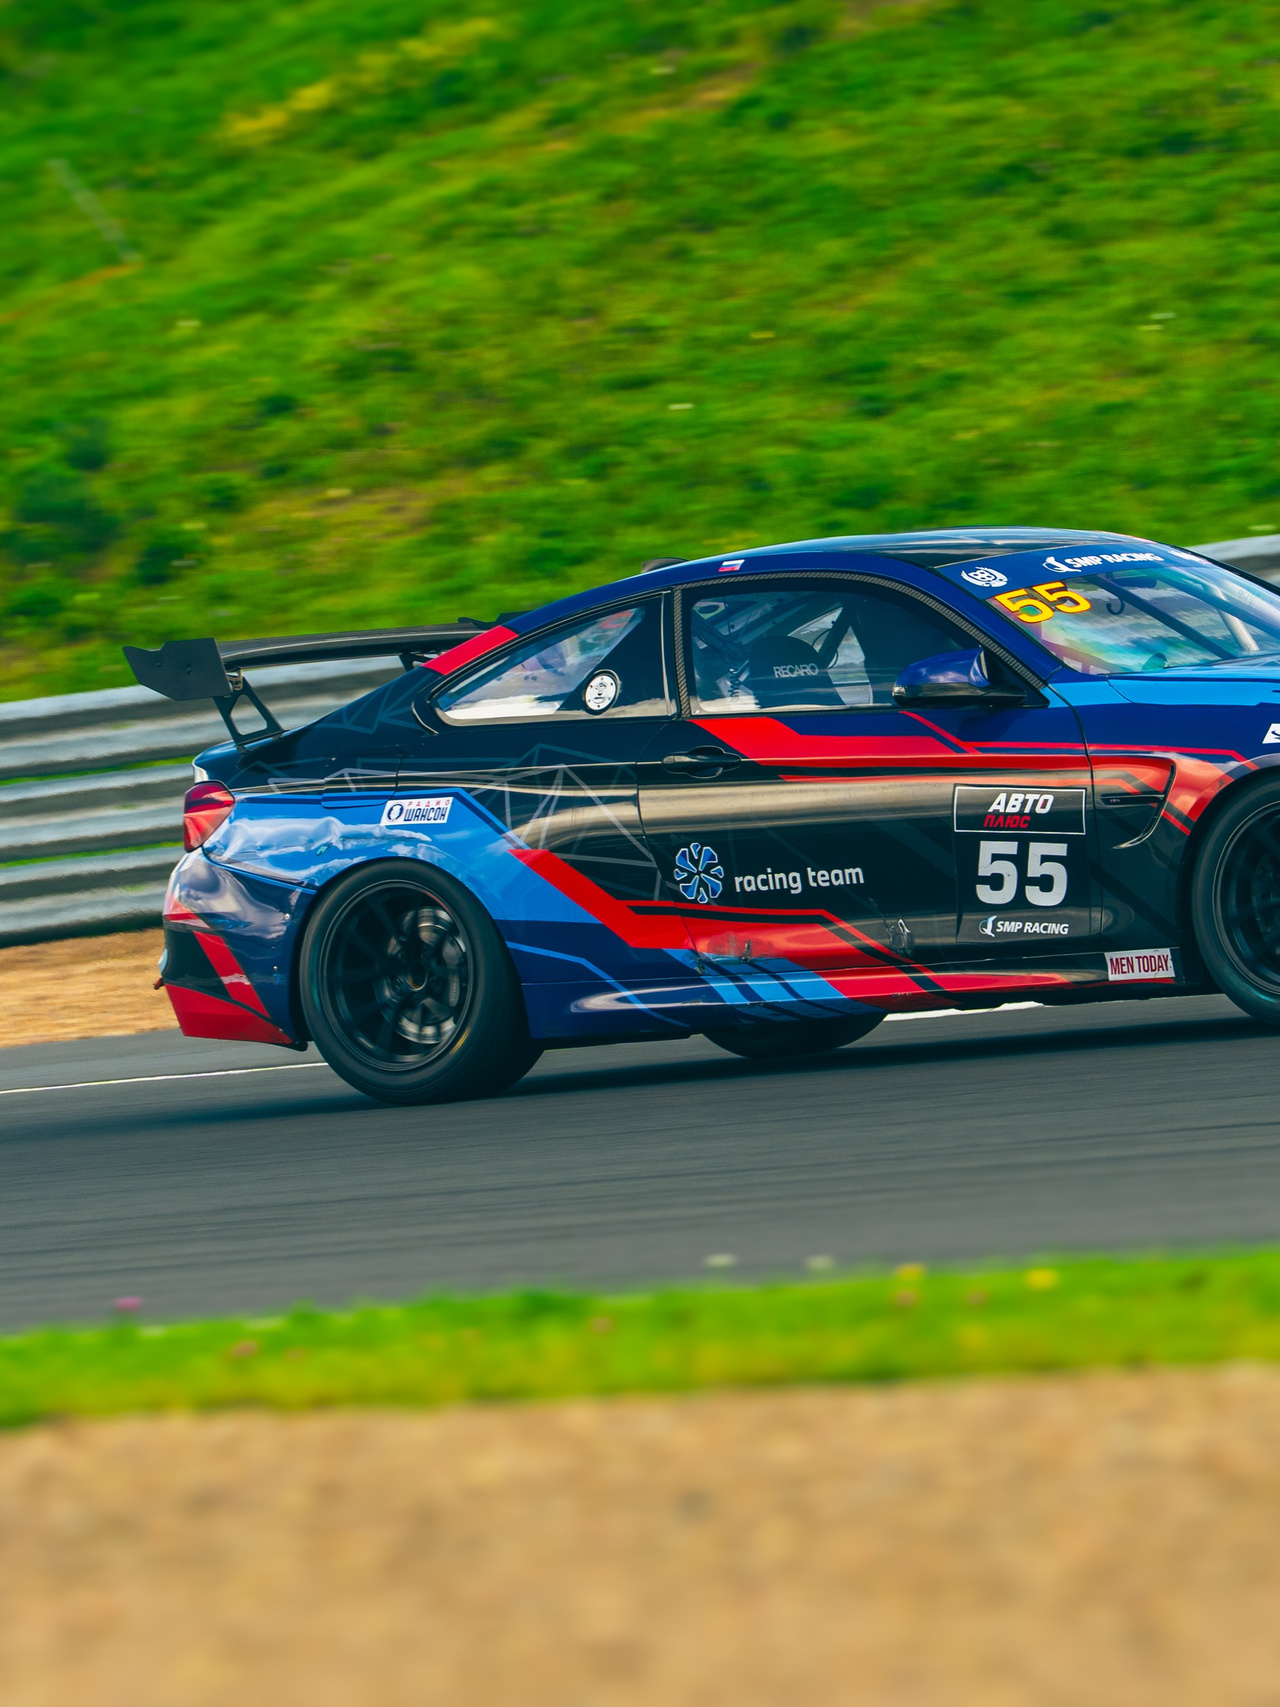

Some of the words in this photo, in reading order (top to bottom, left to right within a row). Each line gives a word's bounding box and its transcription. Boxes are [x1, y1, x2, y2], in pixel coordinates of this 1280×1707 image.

[1064, 554, 1103, 569] SMP
[1103, 553, 1165, 564] RACING
[994, 581, 1092, 623] 55
[773, 663, 819, 678] RECARO
[407, 799, 450, 807] РАДИО
[988, 793, 1054, 814] АВТО
[403, 806, 448, 822] ШАНСОН
[983, 815, 1031, 828] ПЛЮС
[734, 867, 802, 894] racing
[806, 867, 864, 887] team
[975, 840, 1068, 906] 55
[996, 920, 1023, 933] SMP
[1023, 922, 1069, 935] RACING
[1109, 955, 1134, 976] MEN
[1135, 953, 1170, 974] TODAY
